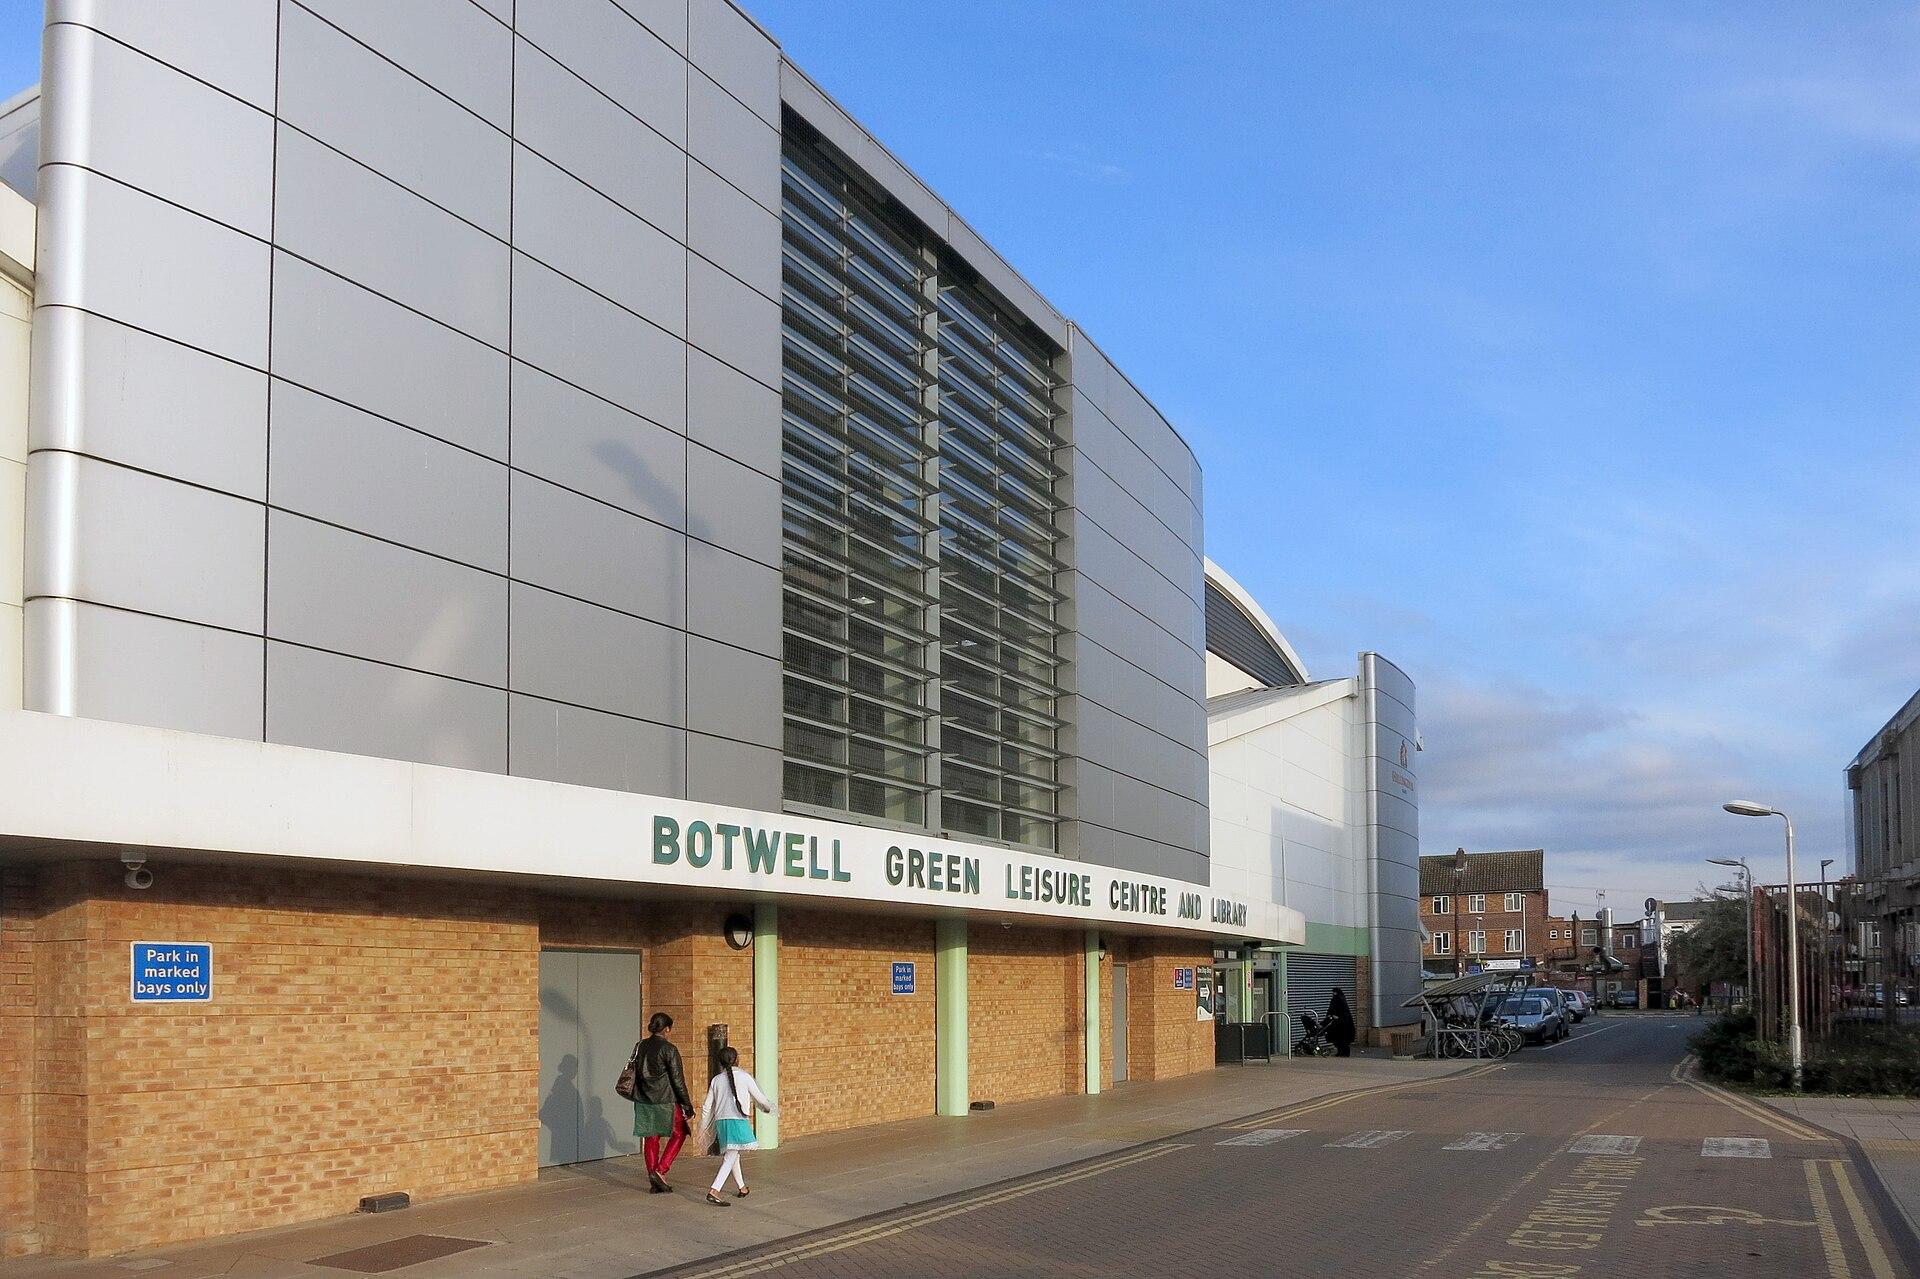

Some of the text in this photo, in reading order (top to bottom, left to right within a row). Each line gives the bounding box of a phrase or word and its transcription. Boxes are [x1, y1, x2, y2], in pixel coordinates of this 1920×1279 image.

[652, 815, 1248, 928] BOTWELL GREEN LEISURE CENTRE AND LIBRARY
[147, 949, 199, 962] Park in
[144, 966, 199, 978] marked
[137, 981, 207, 995] bays only
